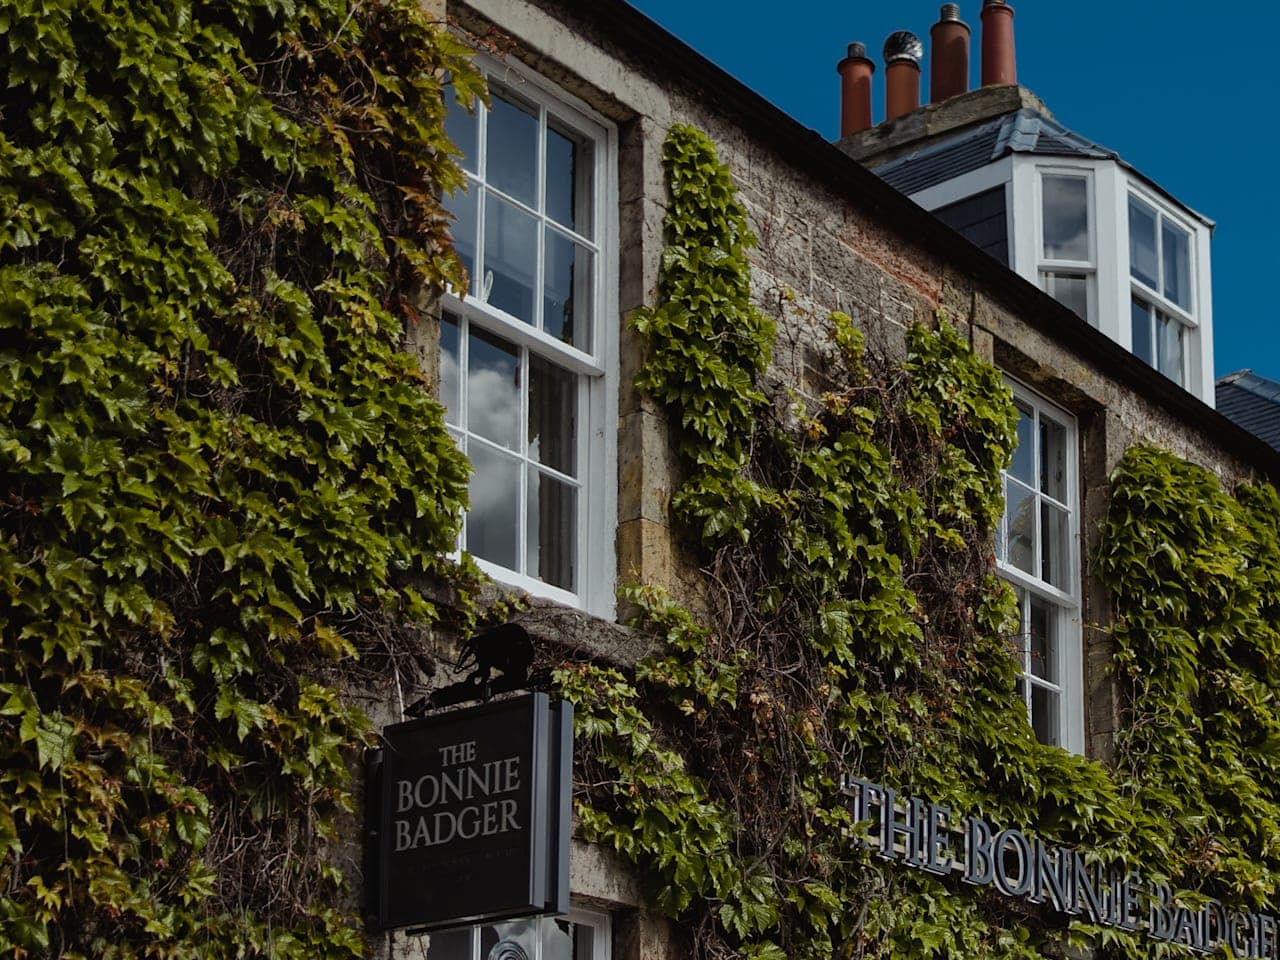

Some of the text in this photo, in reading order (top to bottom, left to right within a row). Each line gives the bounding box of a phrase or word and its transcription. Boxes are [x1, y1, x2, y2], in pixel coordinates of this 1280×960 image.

[438, 741, 477, 767] THE
[397, 757, 521, 812] BONNIE
[394, 799, 522, 851] BADGER
[842, 774, 952, 876] THE
[962, 815, 1142, 930] BONNIE
